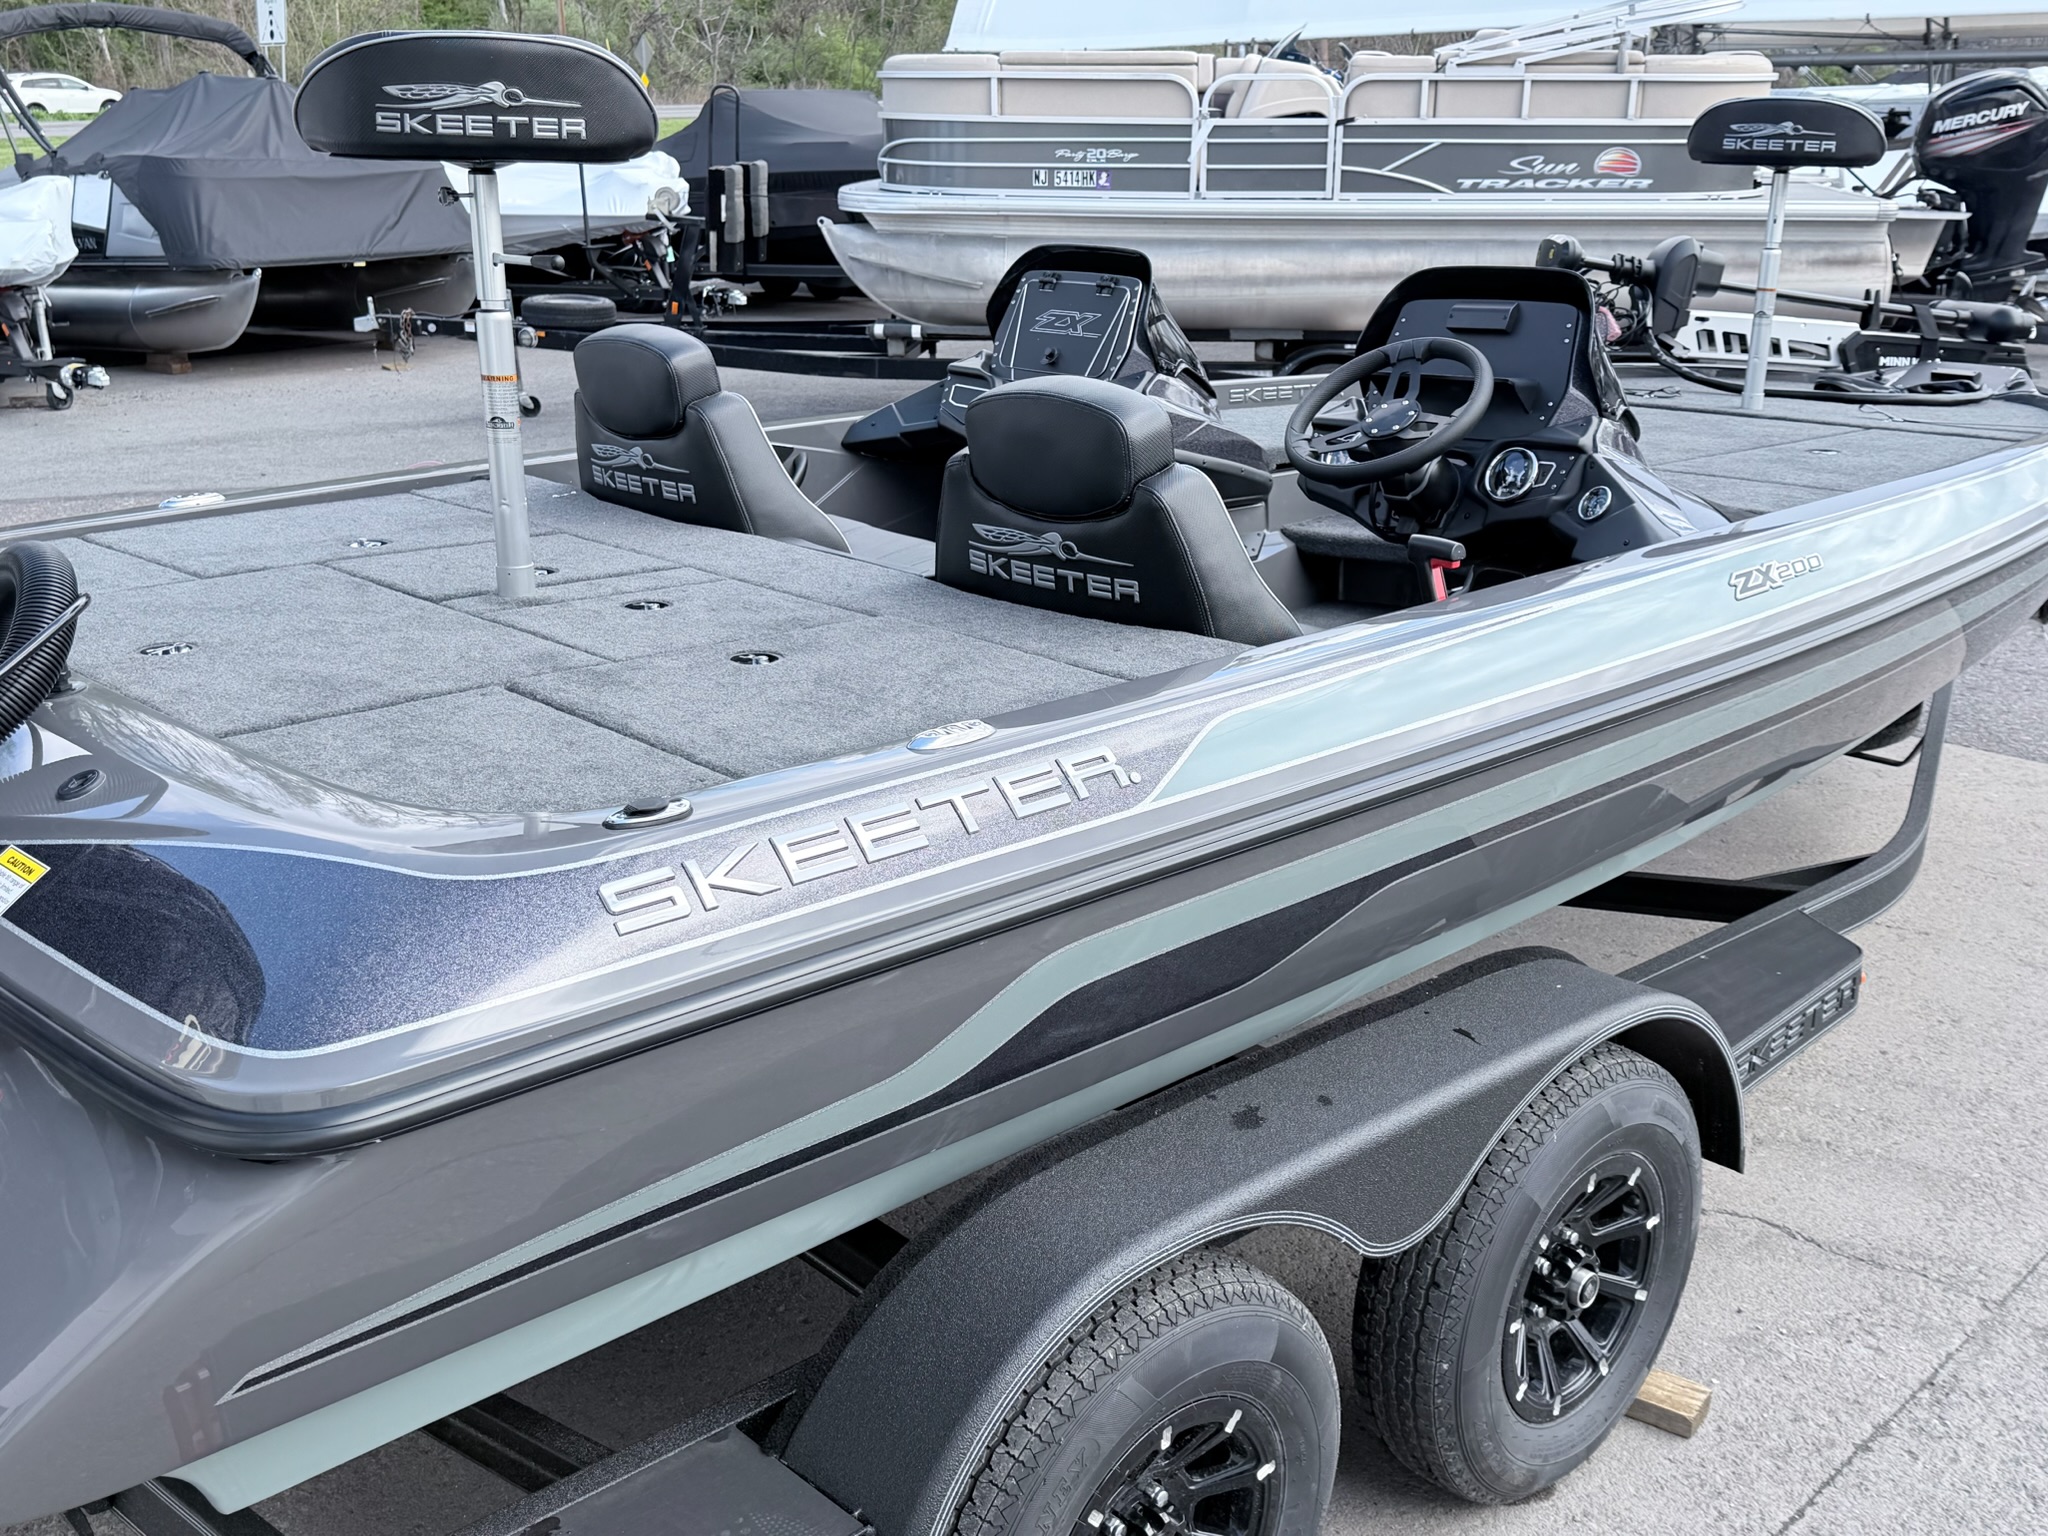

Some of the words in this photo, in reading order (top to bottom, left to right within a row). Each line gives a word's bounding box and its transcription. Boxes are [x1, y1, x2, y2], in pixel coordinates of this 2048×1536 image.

[374, 111, 588, 140] SKEETER
[1931, 100, 2031, 135] MERCURY
[1086, 147, 1107, 159] 20
[1722, 137, 1837, 153] SKEETER
[1498, 155, 1581, 175] Sun
[1033, 169, 1048, 186] NJ
[1054, 169, 1097, 187] 5414HK
[1456, 178, 1654, 190] TRACKER
[1029, 308, 1102, 337] ZX
[1878, 355, 1911, 367] MINN
[1229, 383, 1318, 403] SKEET
[591, 464, 697, 505] SKEETER
[968, 548, 1141, 604] SKEETER
[1728, 553, 1824, 601] ZX200
[599, 745, 1129, 938] SKEETER
[6, 856, 36, 877] CAUTION
